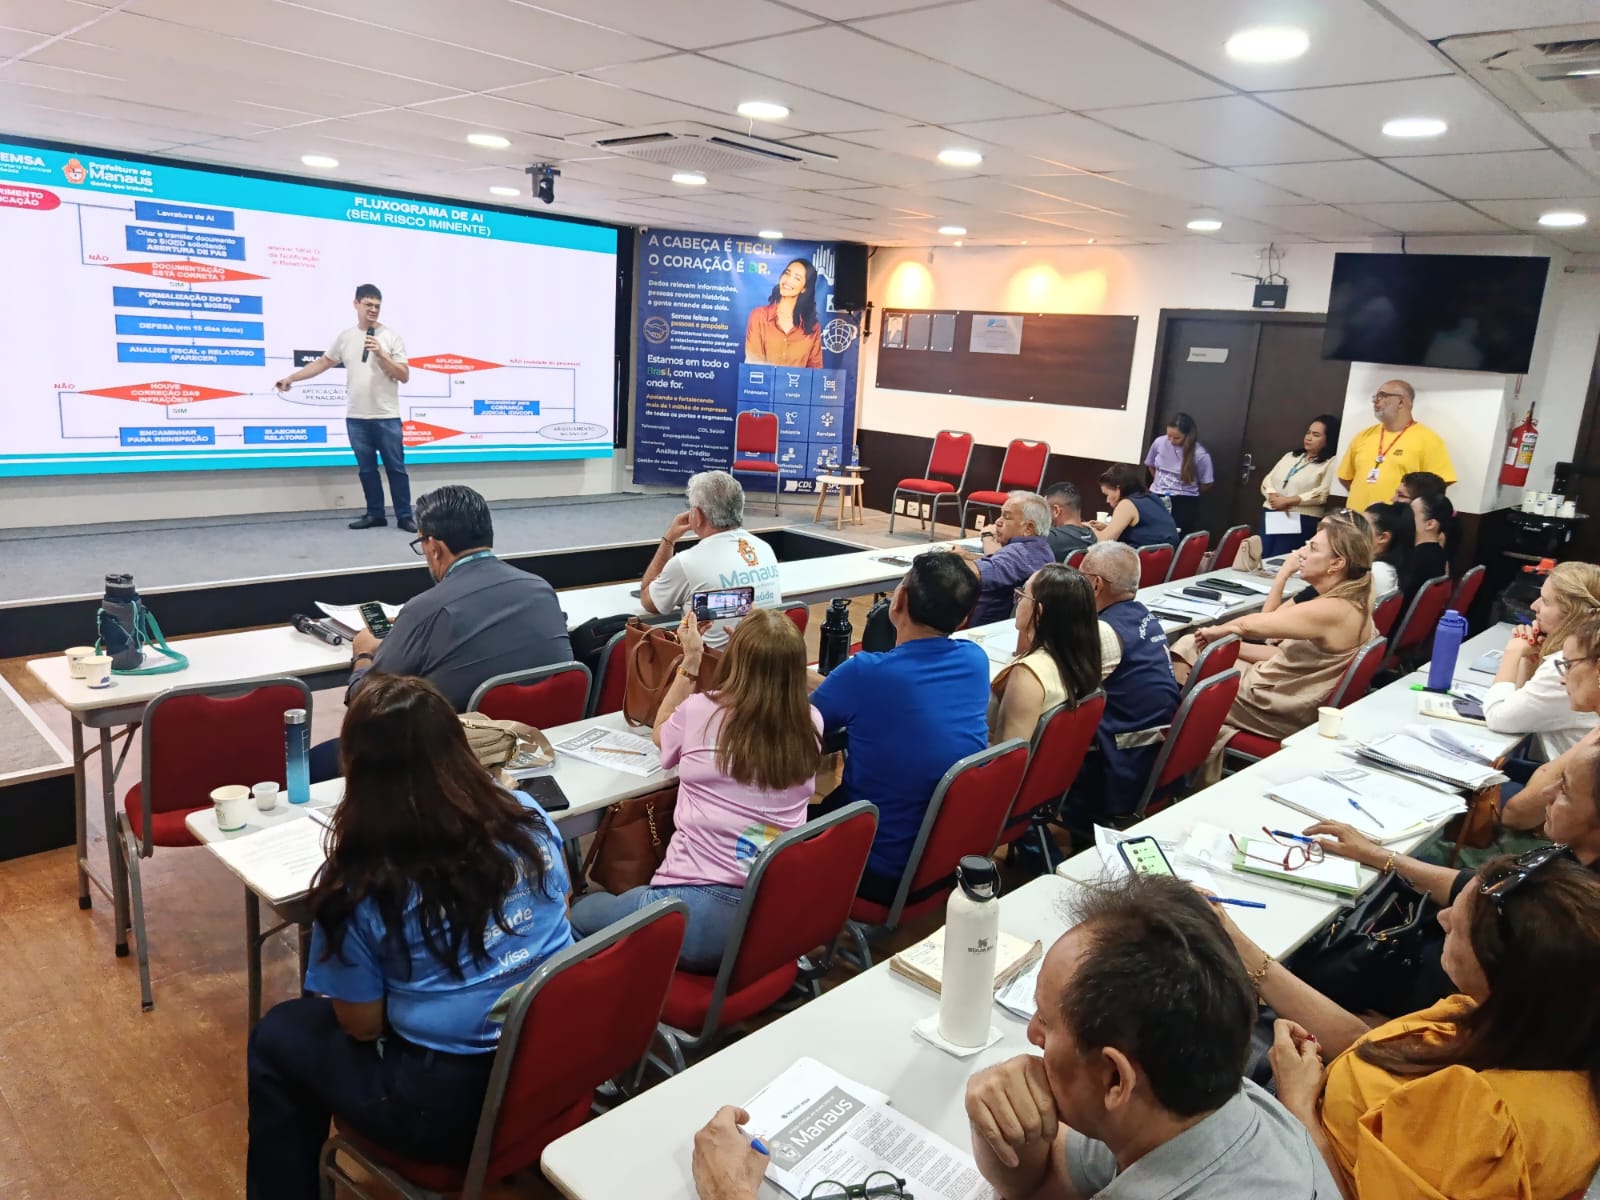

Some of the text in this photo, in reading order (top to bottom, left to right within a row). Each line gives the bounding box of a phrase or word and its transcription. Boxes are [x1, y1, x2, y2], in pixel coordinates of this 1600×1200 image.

[0, 152, 45, 167] EMSA
[89, 162, 152, 177] Prefeitura de
[89, 169, 153, 186] Manaus
[0, 188, 43, 199] RIMENTO
[0, 196, 39, 207] CAÇÃO
[354, 197, 484, 223] FLUXOGRAMA DE AI
[346, 208, 491, 237] (SEM RISCO IMINENTE)
[195, 234, 236, 245] documento
[648, 234, 776, 256] A CABEÇA É TECH.
[147, 244, 195, 255] ABERTURA
[88, 253, 109, 262] NÃO
[648, 253, 659, 266] O
[663, 254, 733, 273] CORAÇÃO
[736, 258, 745, 273] É
[151, 262, 225, 274] DOCUMENTAÇÃO
[177, 271, 217, 280] CORRETA
[648, 279, 669, 288] Dados
[697, 282, 738, 293] informações,
[138, 291, 208, 303] FORMALIZAÇÃO
[648, 290, 673, 299] pessoas
[675, 291, 700, 301] revelam
[673, 301, 700, 309] entende
[671, 312, 691, 321] Somos
[692, 314, 709, 322] feitos
[139, 322, 174, 330] DEFESA
[175, 324, 191, 332] (em
[204, 325, 220, 333] dias
[671, 321, 694, 329] pessoas
[701, 322, 728, 331] propósito
[169, 347, 199, 355] FISCAL
[171, 354, 217, 363] (PARECER)
[648, 354, 684, 366] Estamos
[702, 359, 722, 368] todo
[673, 370, 693, 378] com
[694, 370, 715, 380] você
[646, 379, 684, 389] onde for.
[656, 447, 678, 456] Análise
[688, 449, 711, 458] Crédito
[798, 481, 813, 489] CDL
[755, 591, 774, 602] aúde
[498, 947, 530, 967] Visa
[790, 1098, 853, 1148] Manaus
